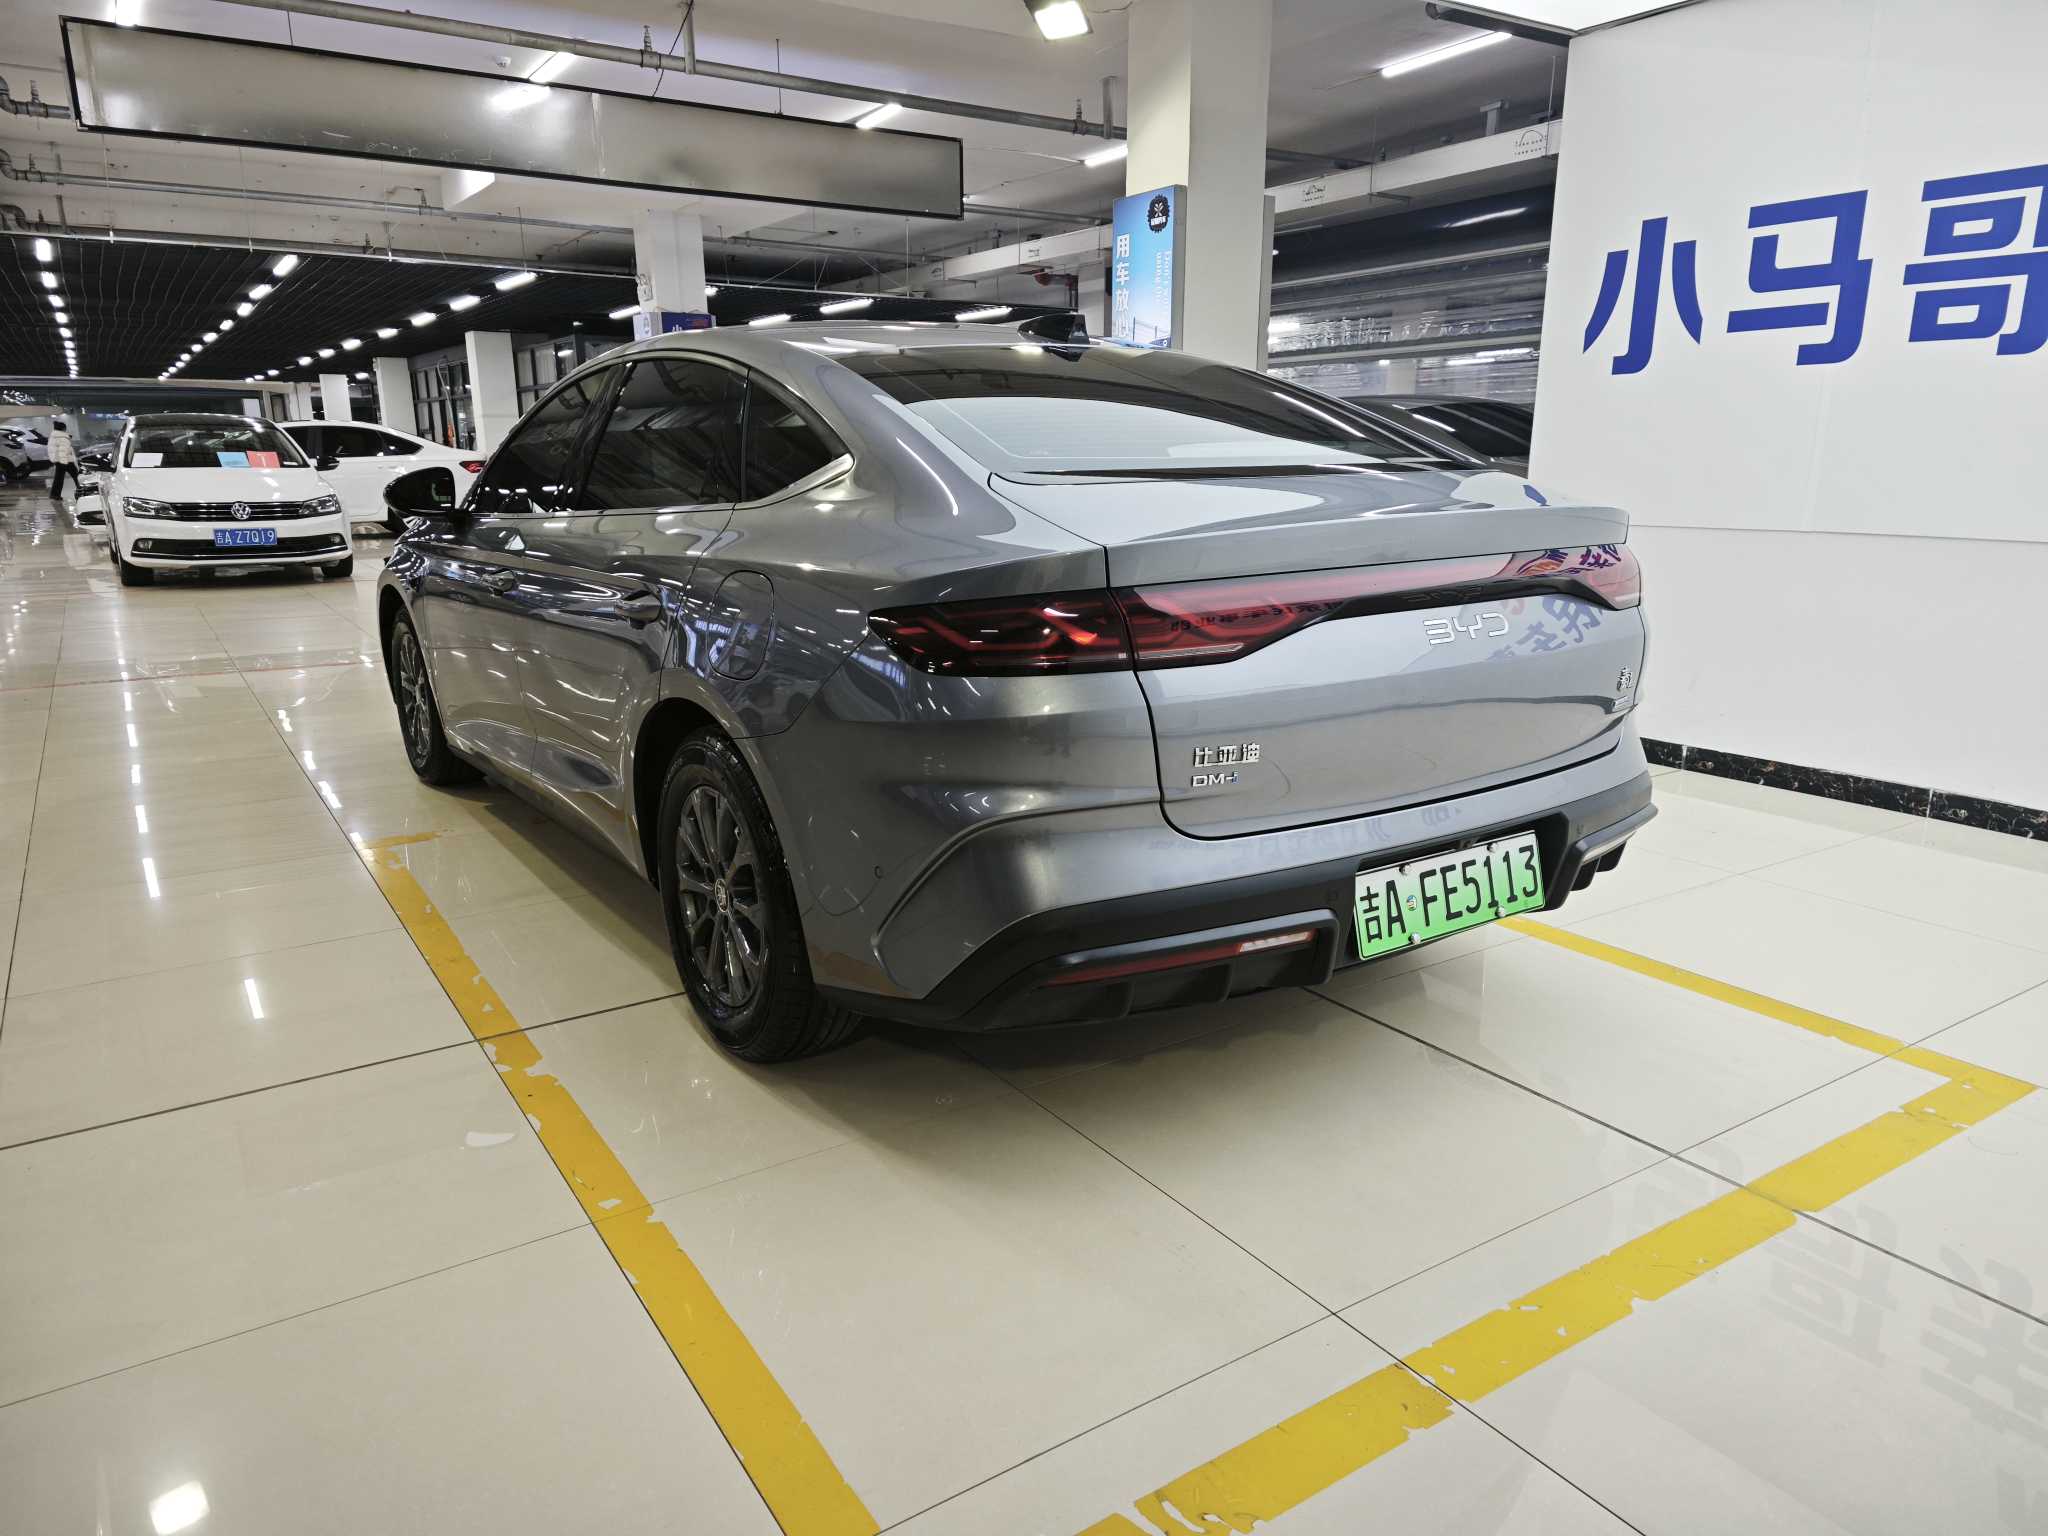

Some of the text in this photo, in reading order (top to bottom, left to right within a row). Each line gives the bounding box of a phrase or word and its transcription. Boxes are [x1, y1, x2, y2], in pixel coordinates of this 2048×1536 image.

[1583, 164, 2048, 375] 小马哥
[1423, 612, 1510, 646] BYD
[1193, 742, 1260, 768] 比亚迪
[1192, 771, 1240, 787] DM-i
